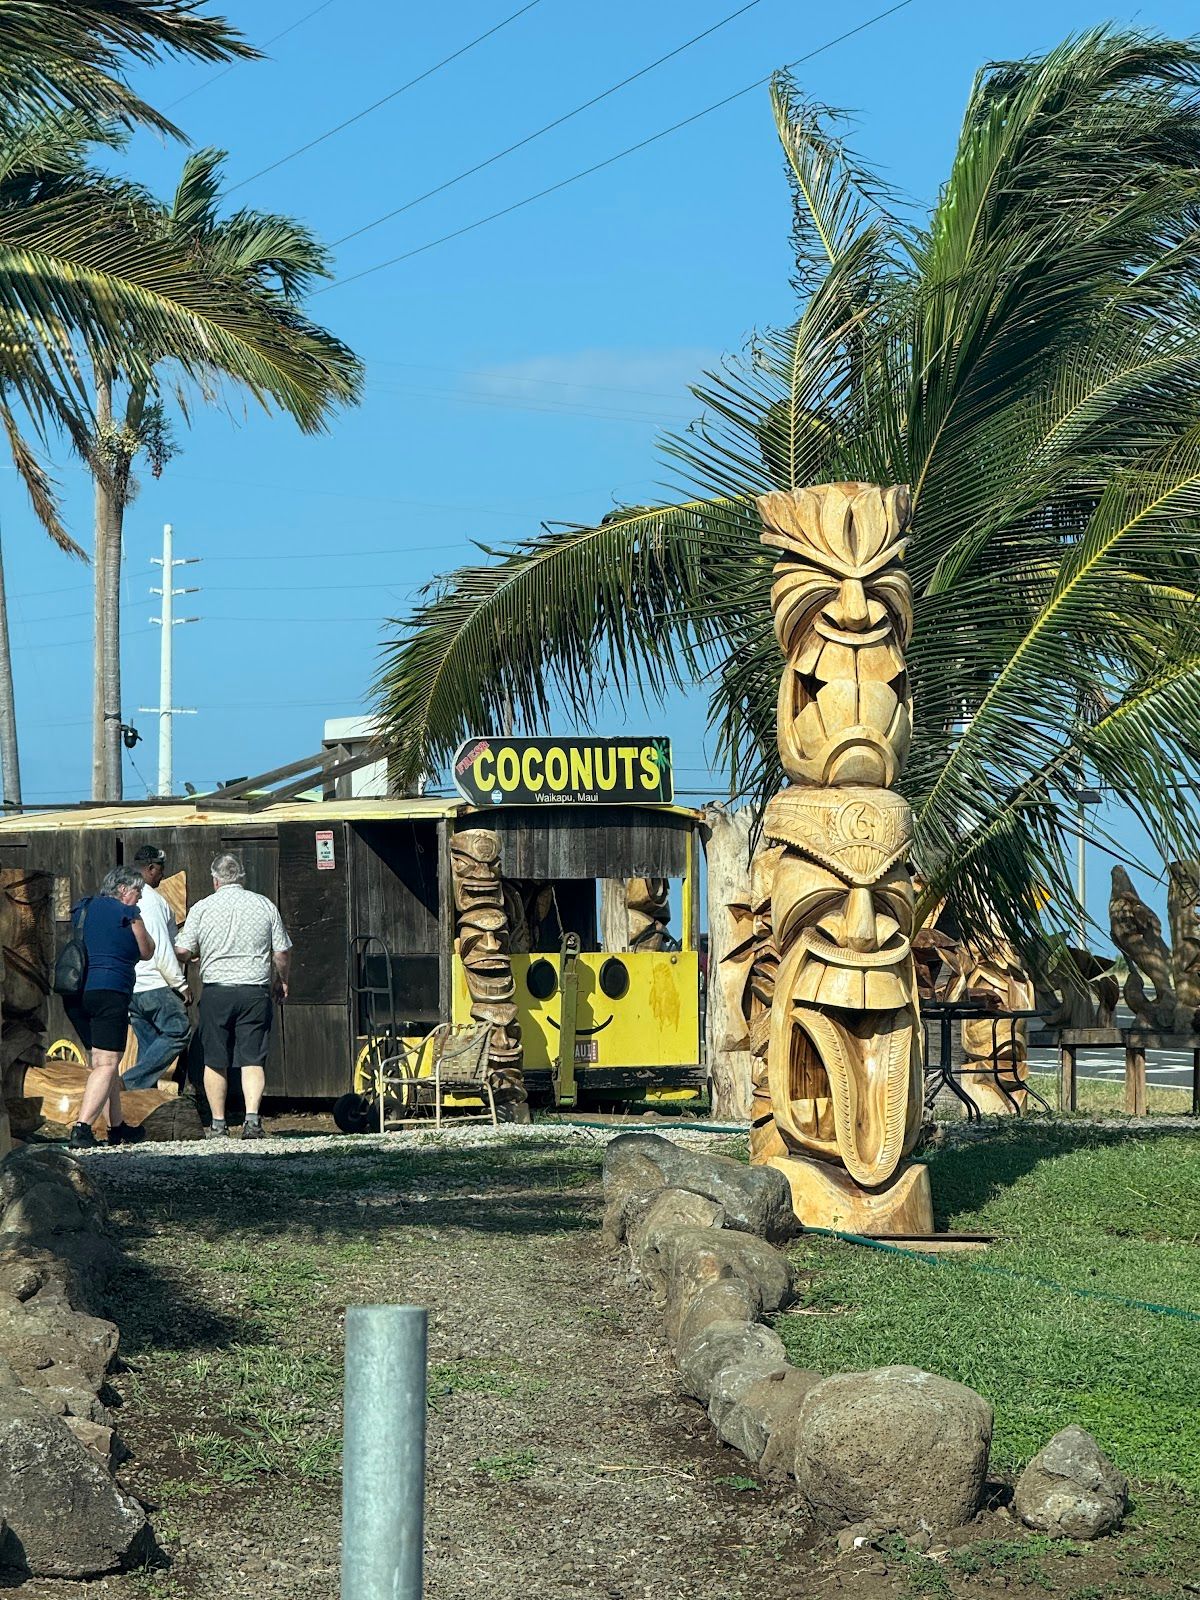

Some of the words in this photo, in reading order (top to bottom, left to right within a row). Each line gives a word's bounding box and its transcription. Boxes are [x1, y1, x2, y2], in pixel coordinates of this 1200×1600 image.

[456, 741, 490, 775] FRESH
[473, 746, 660, 791] COCONUTS
[535, 793, 575, 803] Waikapu,
[577, 792, 599, 802] Maui
[575, 1044, 592, 1057] AUI
